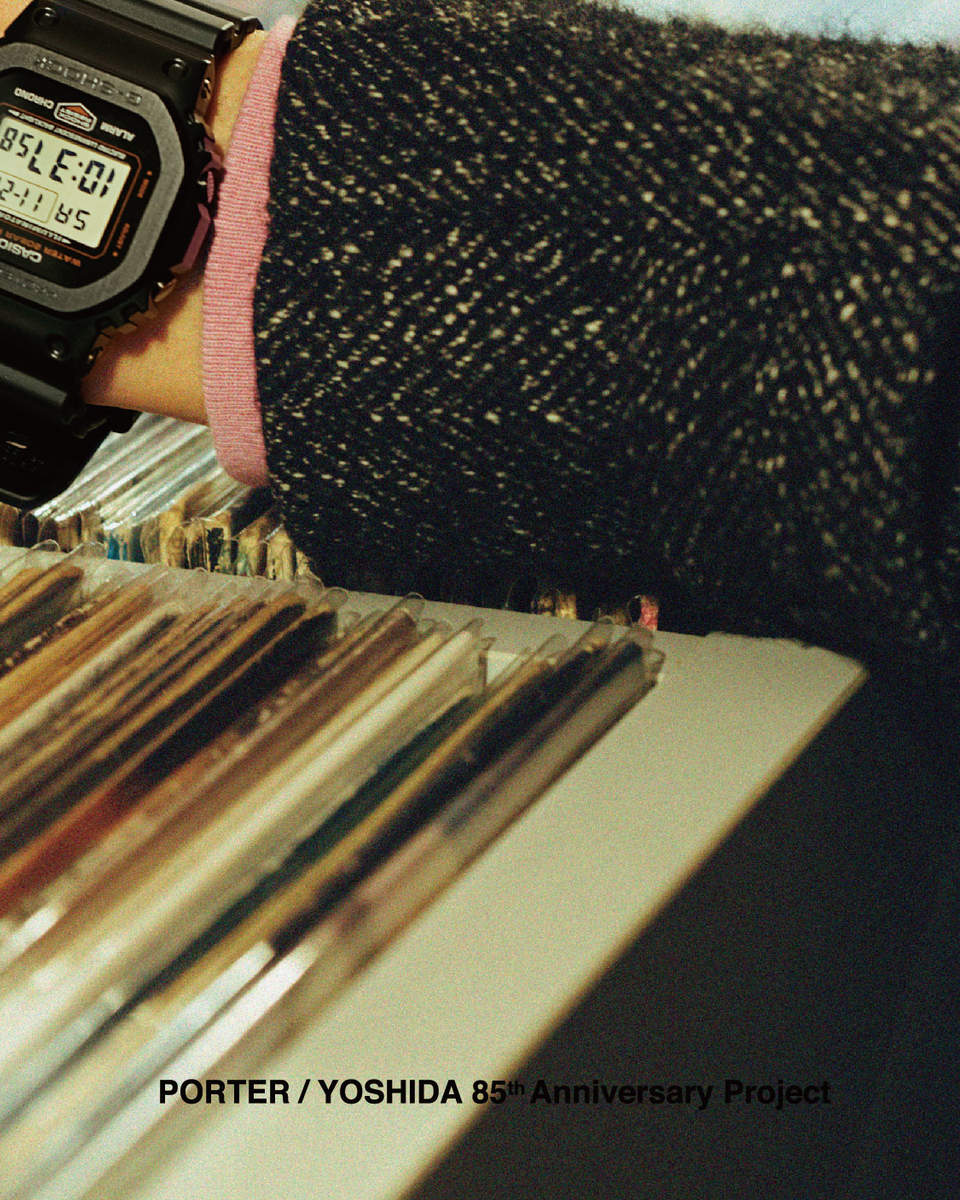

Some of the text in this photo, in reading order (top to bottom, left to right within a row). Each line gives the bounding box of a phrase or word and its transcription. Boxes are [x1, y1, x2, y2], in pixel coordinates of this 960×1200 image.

[35, 57, 142, 105] G-SHOCK
[14, 87, 136, 142] ALARM CHRONO
[0, 126, 116, 198] 10:37 58
[54, 202, 91, 231] SA
[43, 246, 81, 268] WATER
